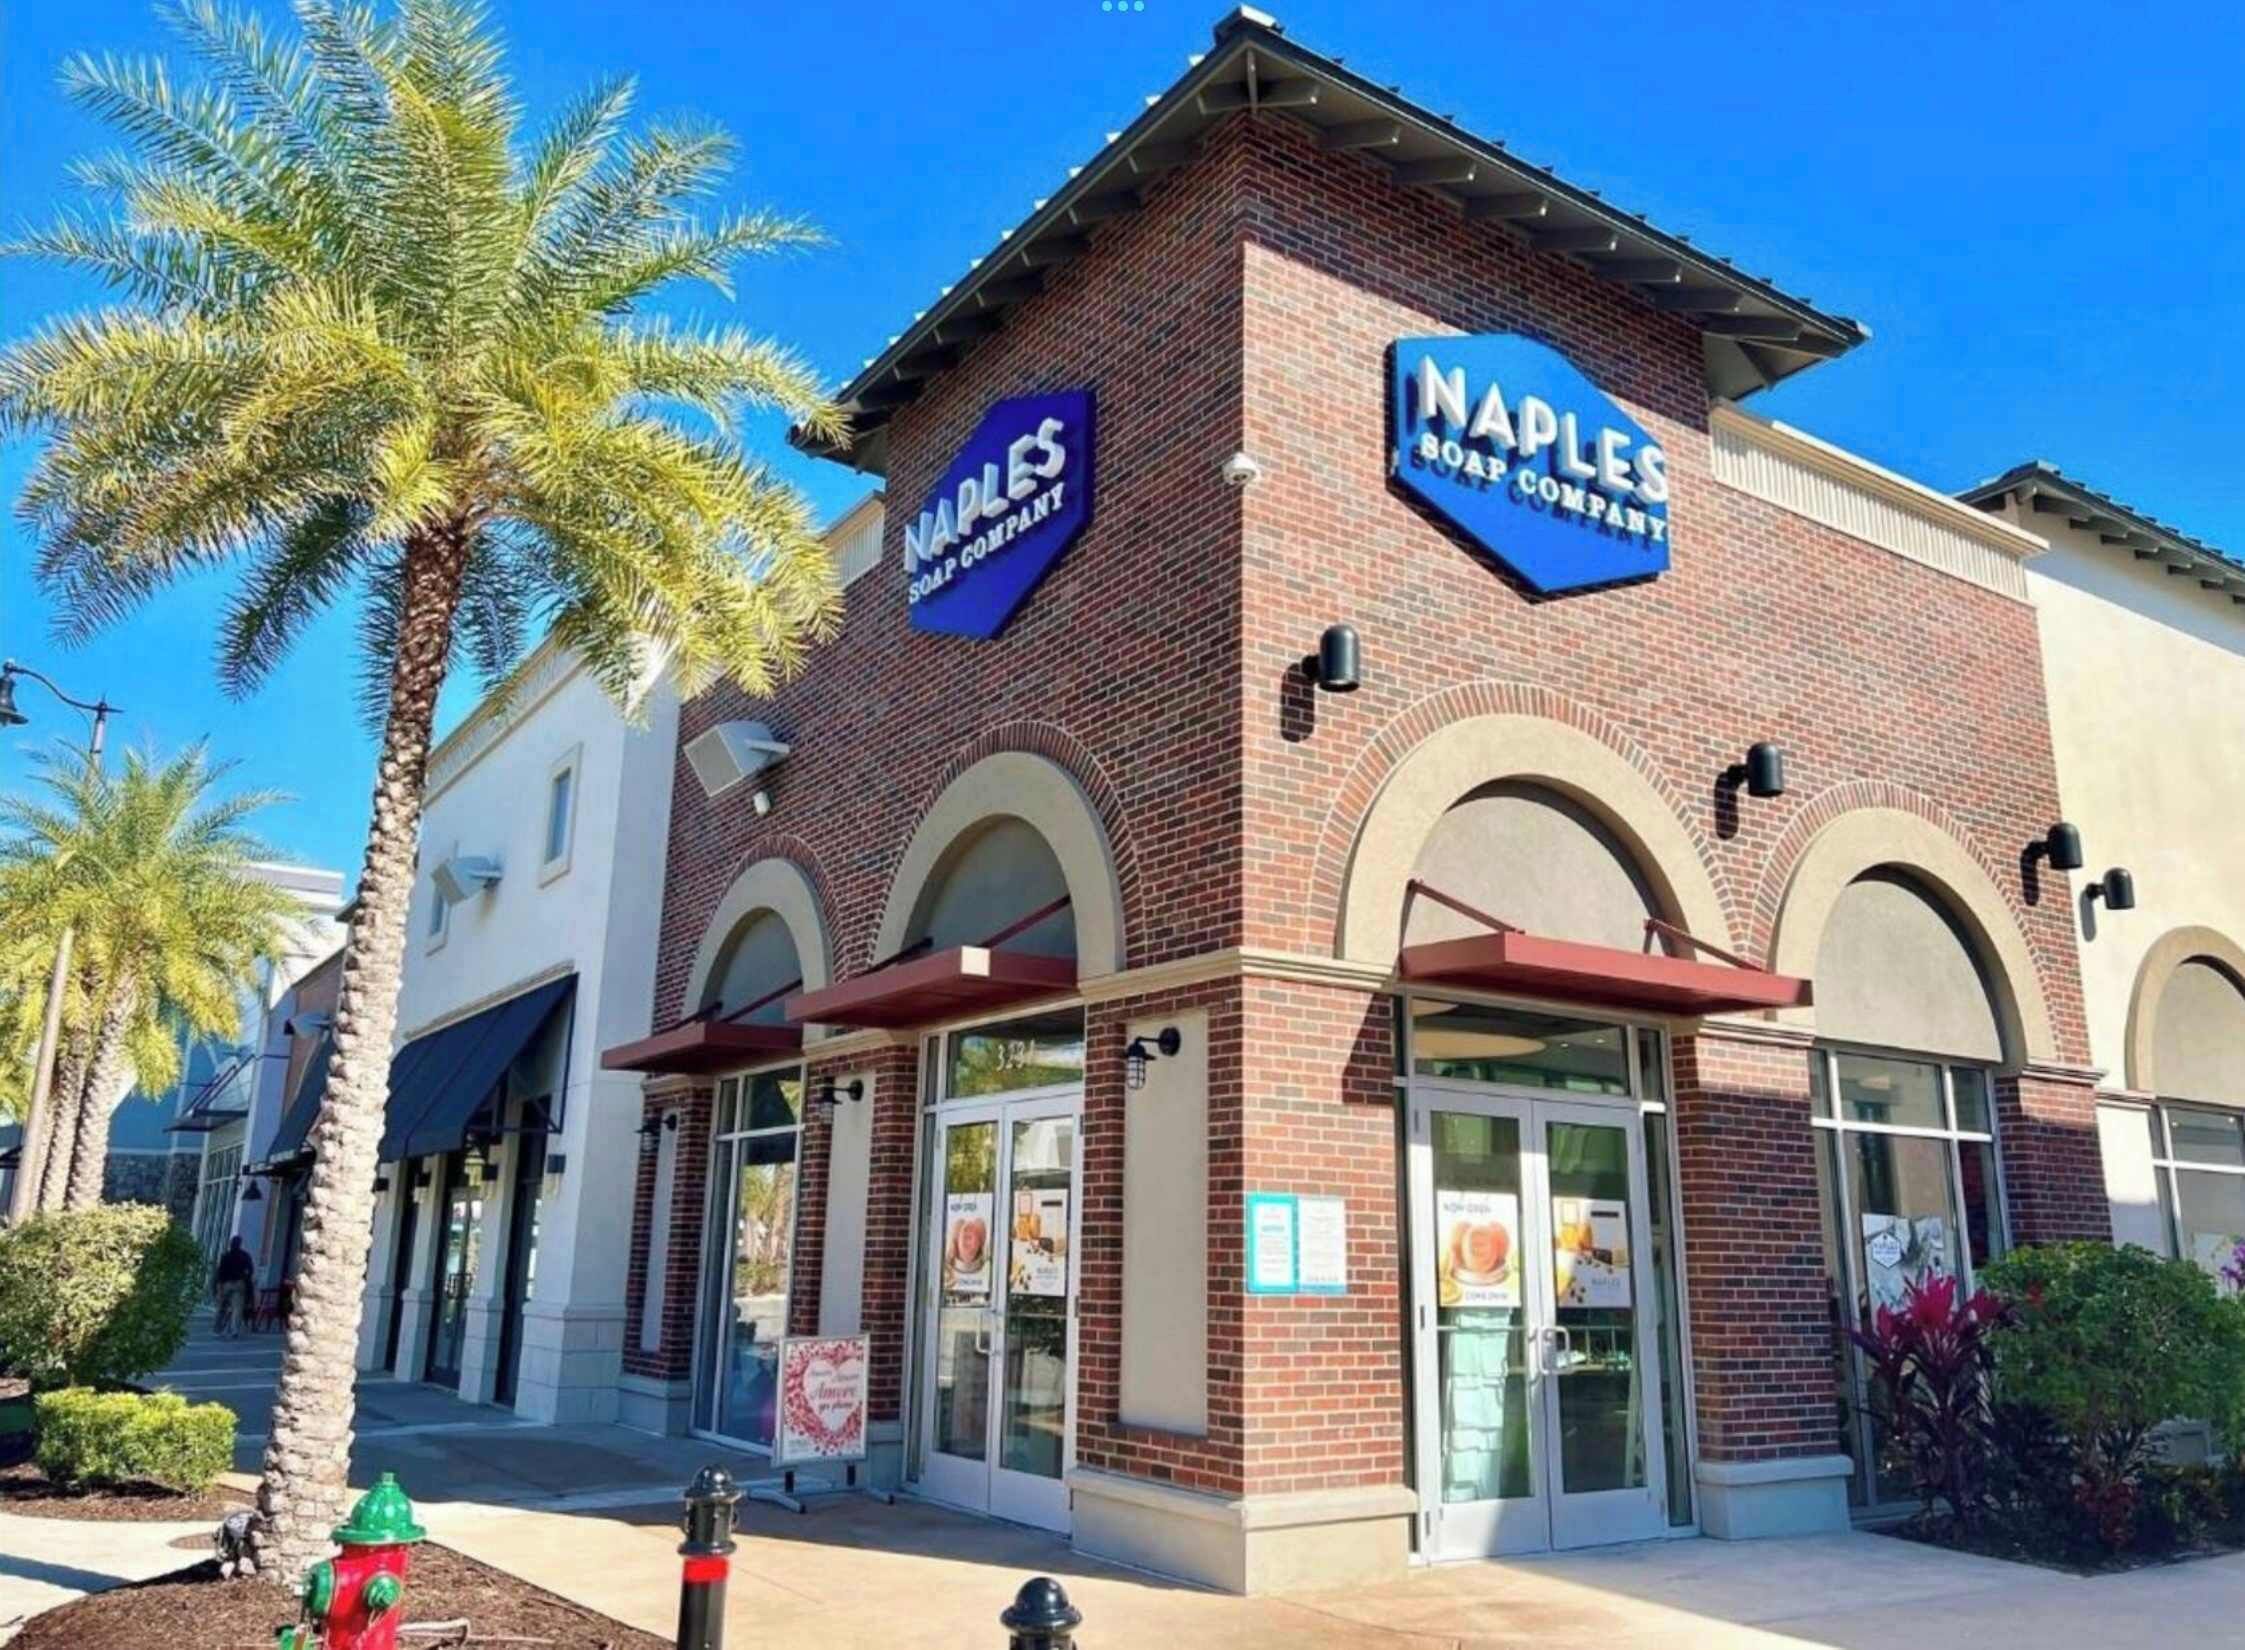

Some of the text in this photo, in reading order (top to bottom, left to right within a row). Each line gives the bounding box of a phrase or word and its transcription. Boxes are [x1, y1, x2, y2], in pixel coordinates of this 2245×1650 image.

[904, 416, 1067, 574] NAPLES
[1417, 354, 1668, 505] NAPLES
[1419, 432, 1668, 543] SOAP COMPANY
[908, 482, 1067, 605] SOAP COMPANY
